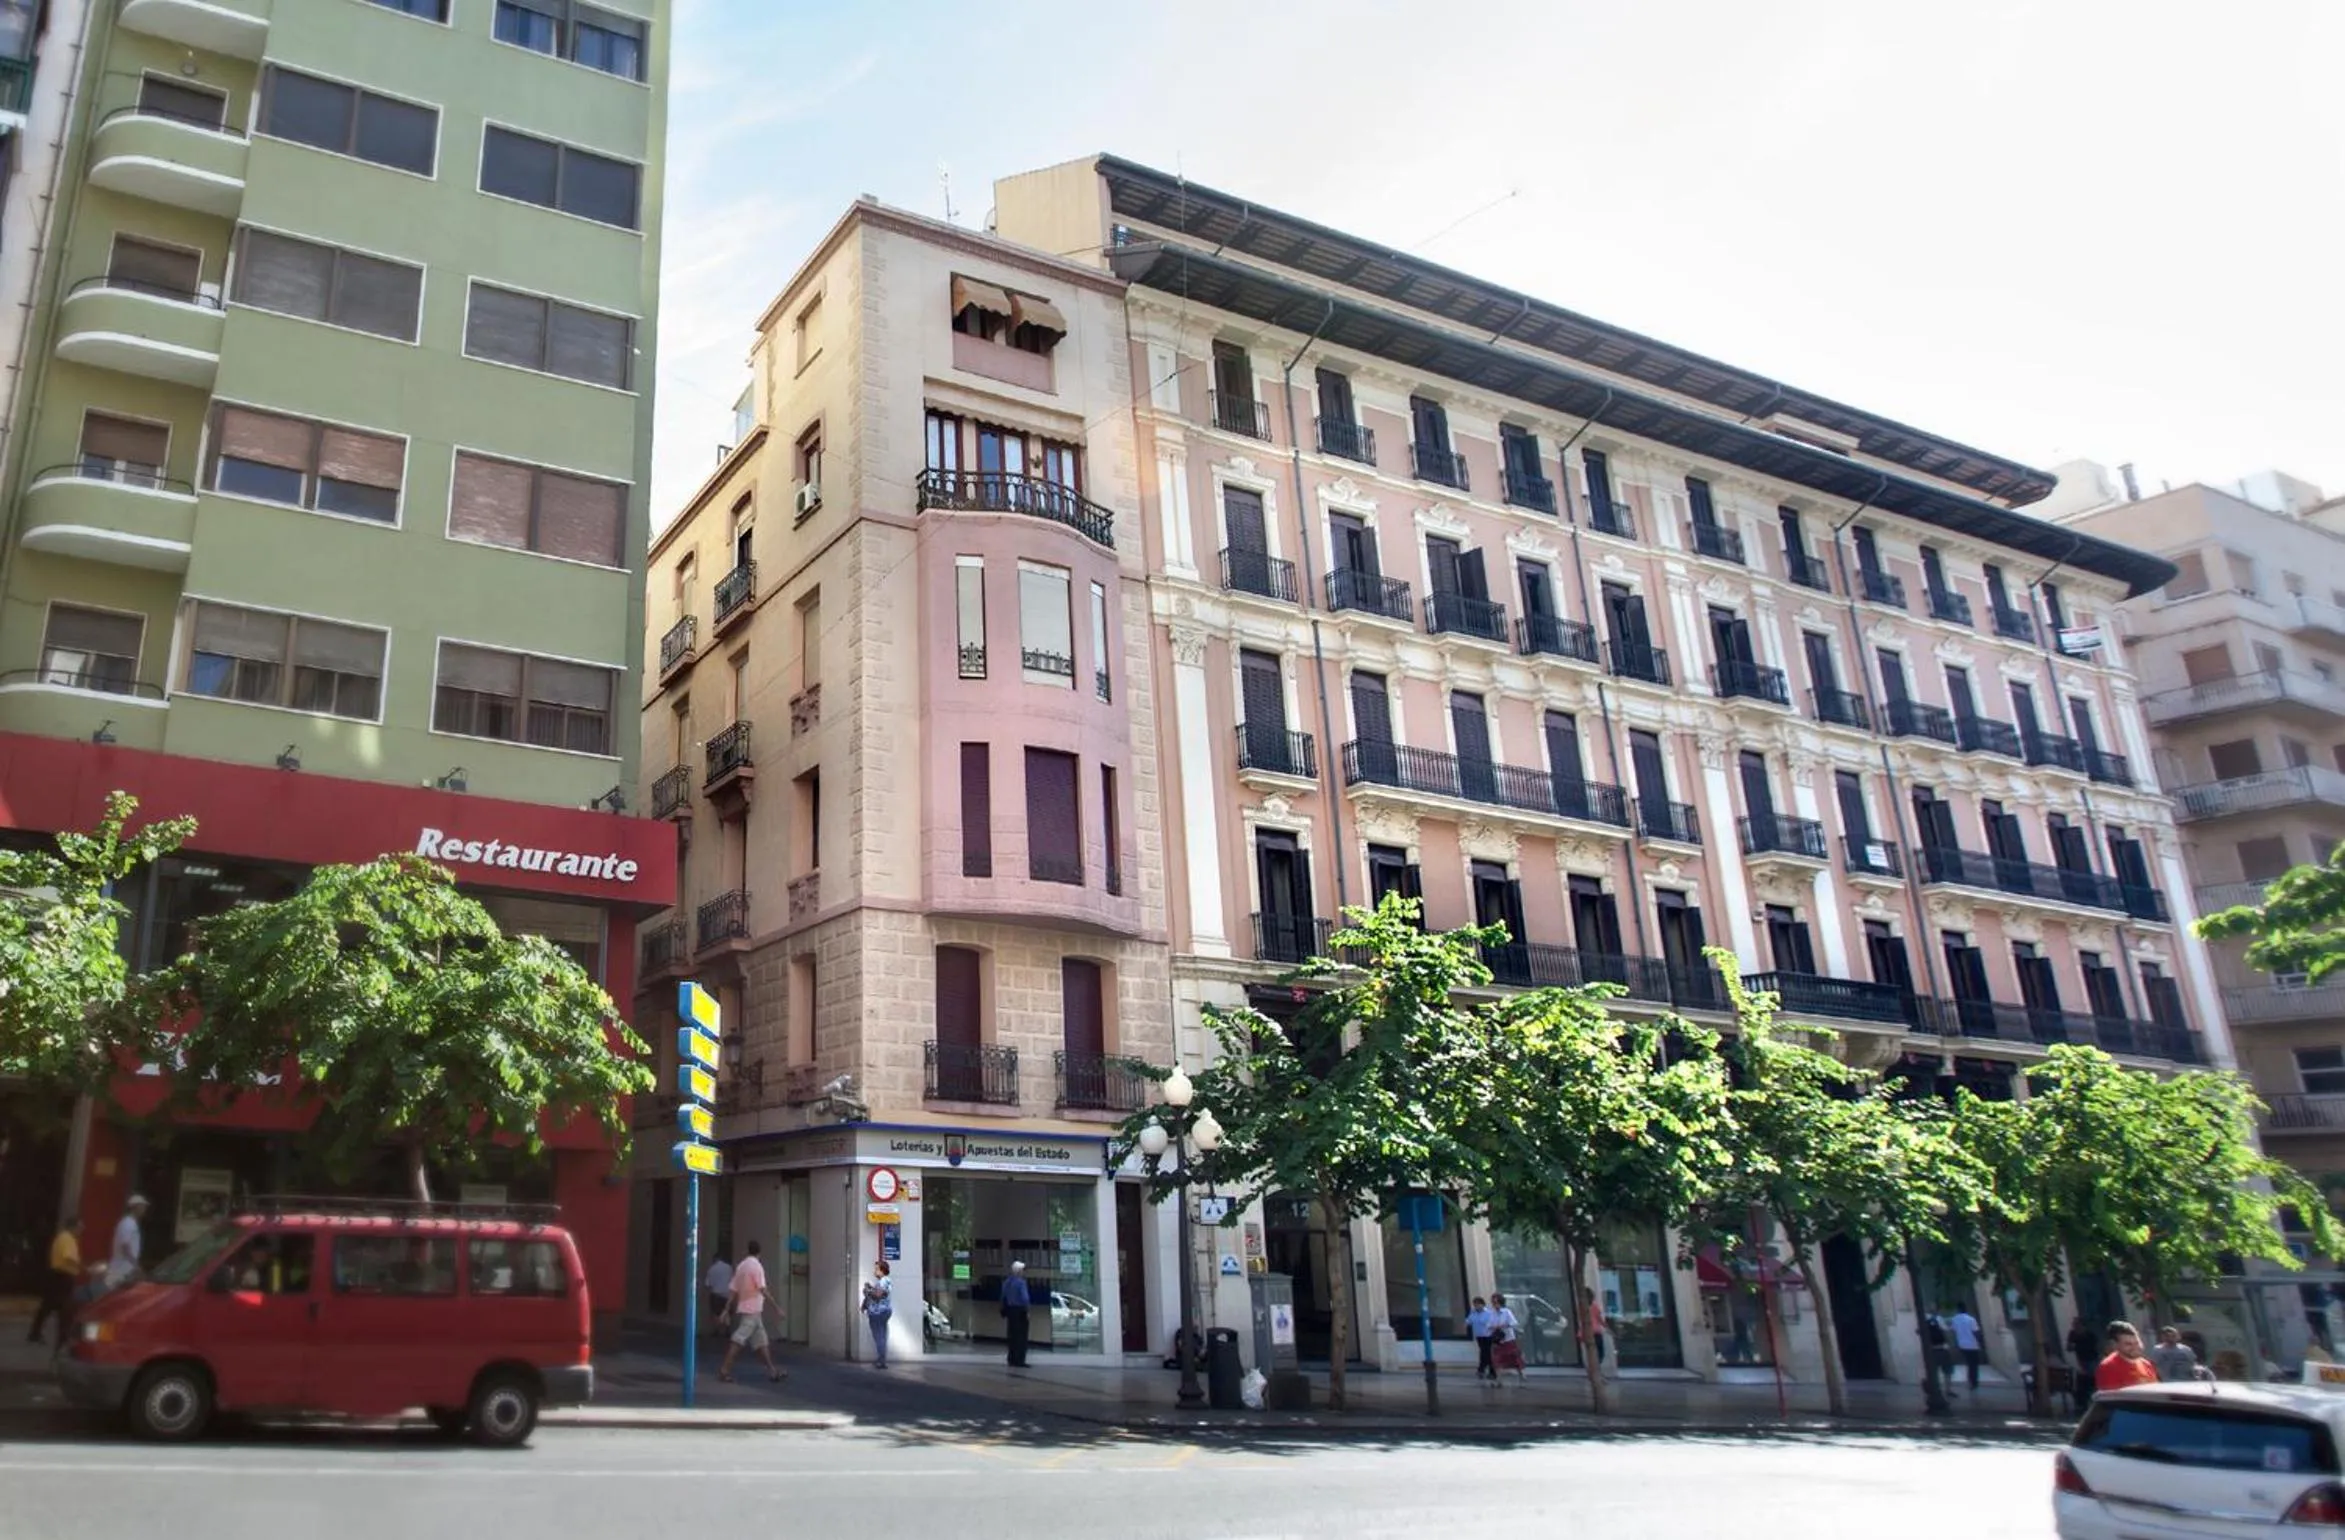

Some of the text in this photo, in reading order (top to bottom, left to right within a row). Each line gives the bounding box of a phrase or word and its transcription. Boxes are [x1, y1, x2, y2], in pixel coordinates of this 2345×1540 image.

[415, 827, 638, 881] Restaurante
[936, 1144, 944, 1155] y
[967, 1143, 1014, 1157] Apuestas
[1017, 1146, 1033, 1158] del
[1035, 1149, 1070, 1160] Estado
[1292, 1203, 1310, 1217] 12
